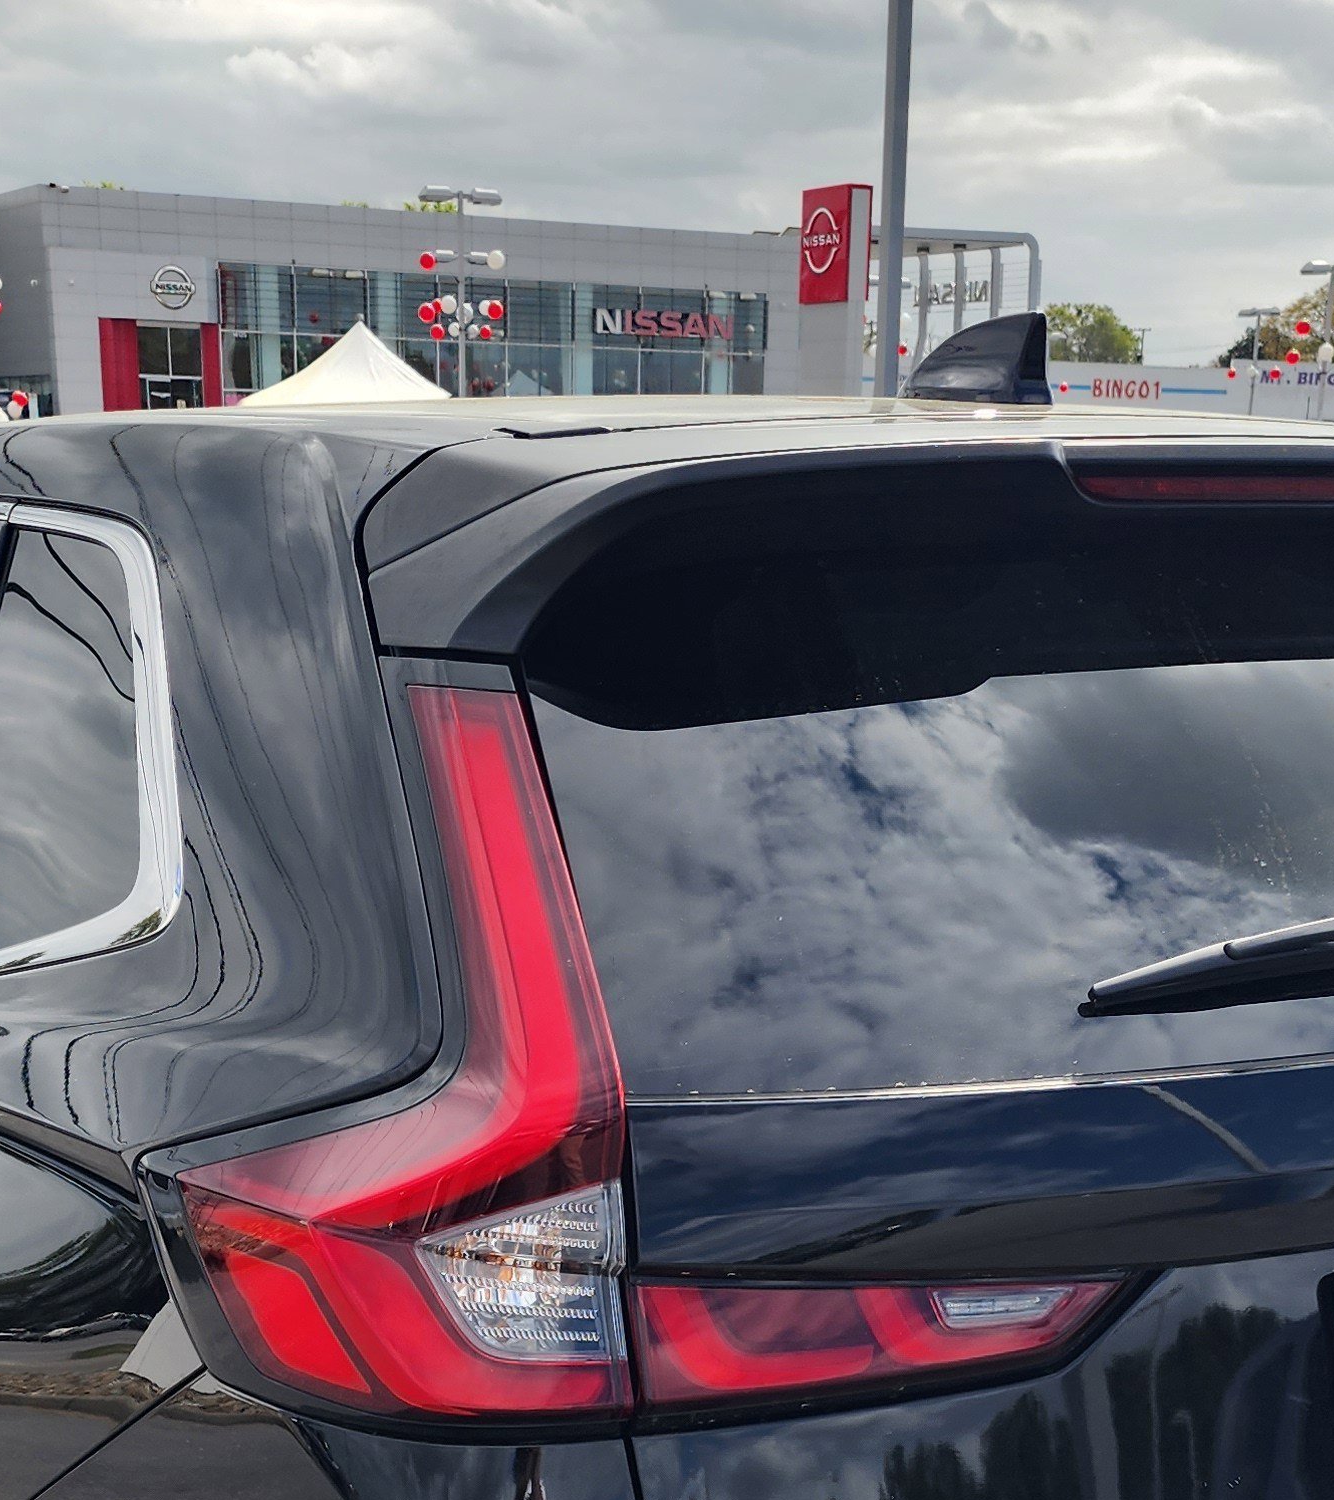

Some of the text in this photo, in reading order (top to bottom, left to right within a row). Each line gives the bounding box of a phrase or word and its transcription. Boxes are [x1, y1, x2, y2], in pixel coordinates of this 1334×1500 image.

[802, 233, 840, 248] NISSAN
[155, 283, 192, 292] NISSAN
[595, 308, 734, 341] NISSAN
